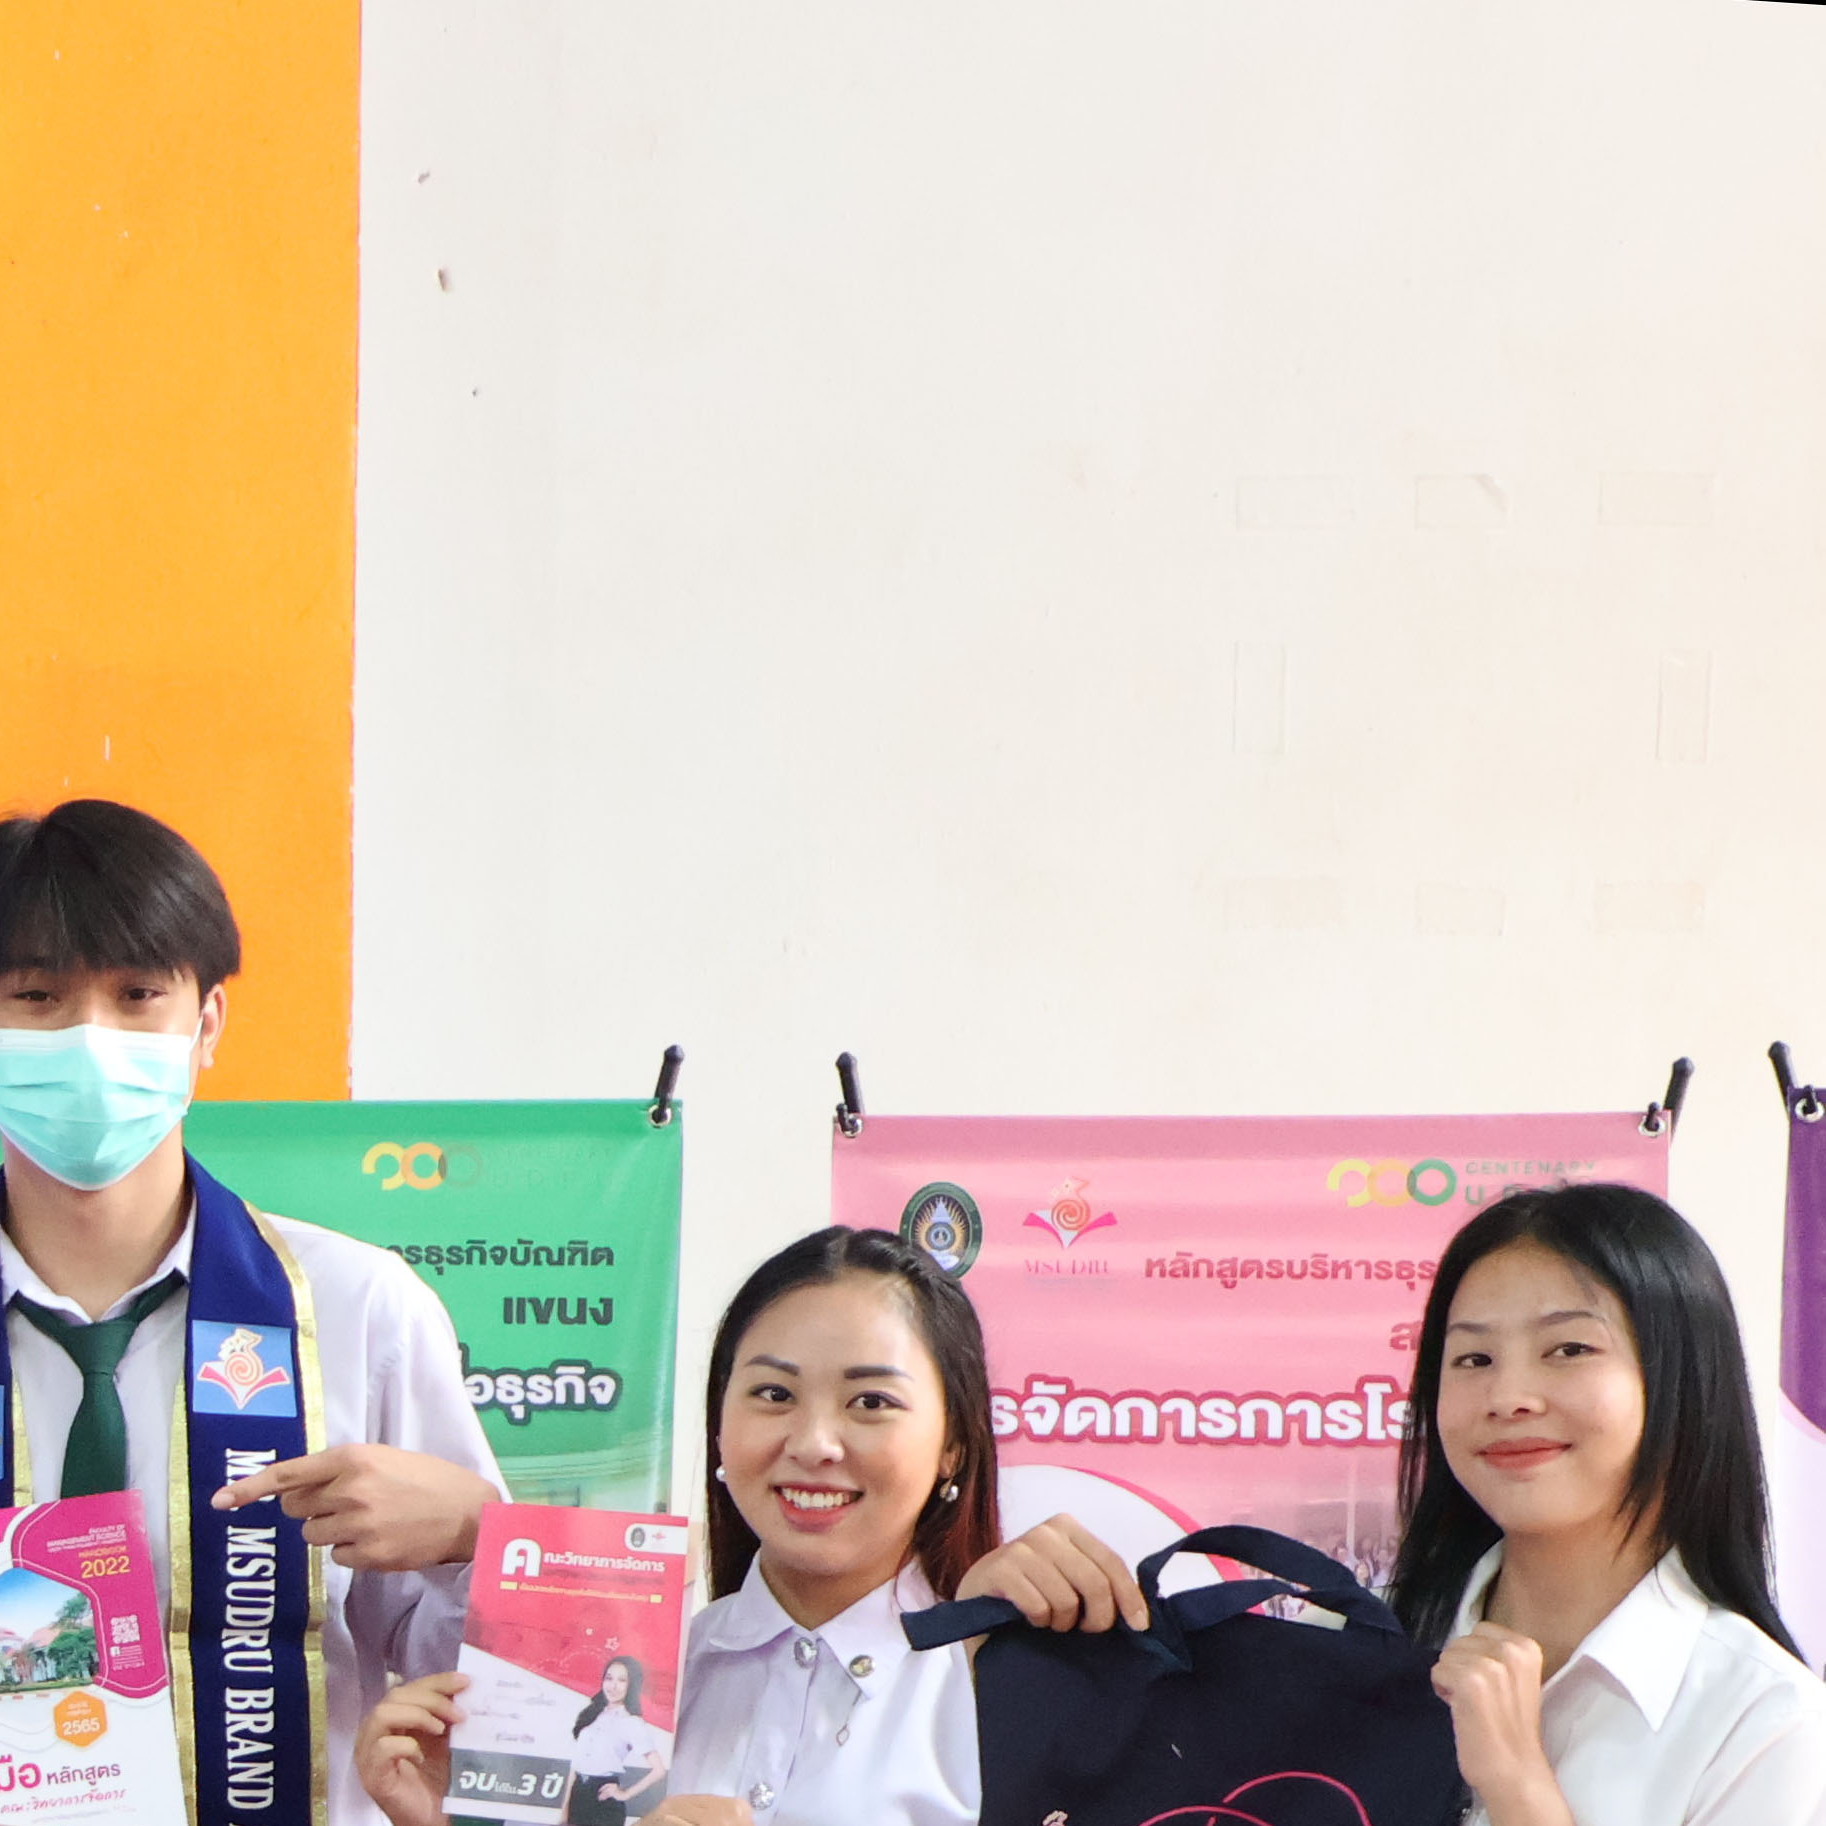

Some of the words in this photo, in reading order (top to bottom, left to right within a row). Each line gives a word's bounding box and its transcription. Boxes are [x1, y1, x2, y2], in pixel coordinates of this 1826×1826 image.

[1465, 1161, 1597, 1176] CENTENARY
[384, 1238, 615, 1276] รธุรกิจบัณฑิต
[503, 1297, 614, 1326] แขนง
[79, 1555, 131, 1579] 2022
[225, 1525, 278, 1675] MSUDRU
[61, 1718, 101, 1736] 2565
[225, 1687, 277, 1812] BRAND
[45, 1760, 121, 1787] หลักสูตร
